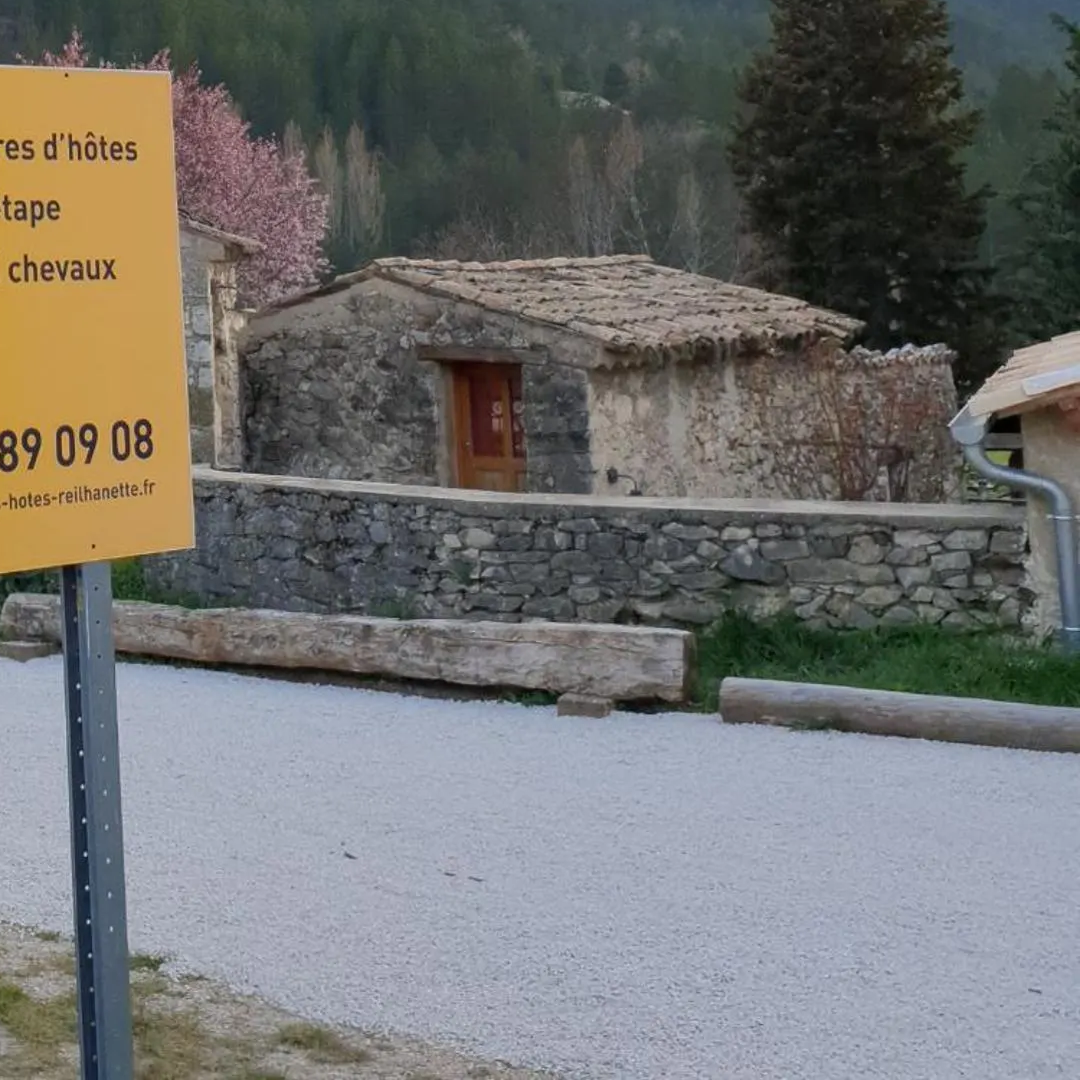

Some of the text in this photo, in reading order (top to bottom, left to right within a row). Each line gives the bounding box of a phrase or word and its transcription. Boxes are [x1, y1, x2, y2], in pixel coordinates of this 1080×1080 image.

[44, 131, 138, 161] d'hôtes
[8, 254, 117, 284] chevaux
[55, 422, 99, 468] 09
[111, 418, 155, 461] 08
